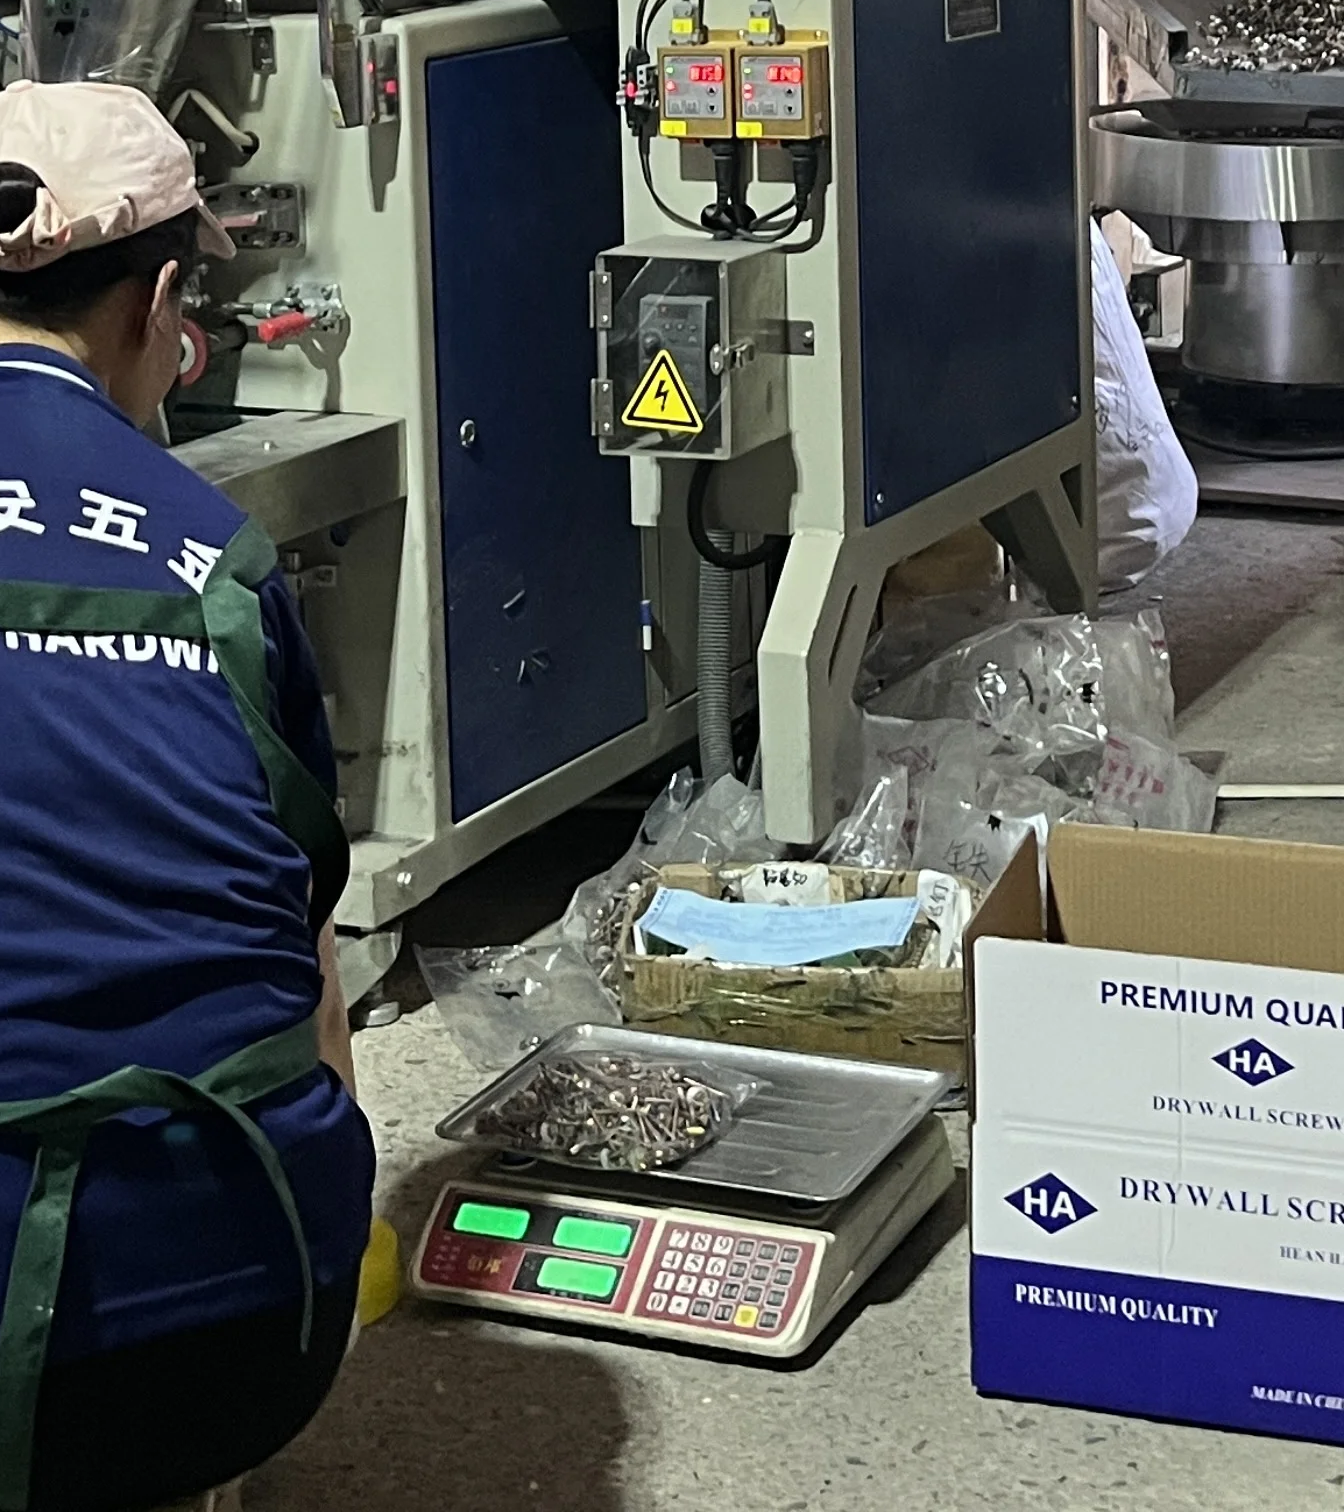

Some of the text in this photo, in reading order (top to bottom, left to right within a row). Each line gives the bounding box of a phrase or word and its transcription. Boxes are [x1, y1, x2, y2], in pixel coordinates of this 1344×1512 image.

[1100, 980, 1254, 1020] PREMIUM
[1228, 1049, 1277, 1077] HA
[1152, 1095, 1262, 1123] DRYWALL
[1022, 1186, 1078, 1222] HA
[1120, 1176, 1279, 1217] DRYWALL
[1015, 1283, 1218, 1328] PREMIUM QUALITY
[1250, 1385, 1295, 1404] MADE
